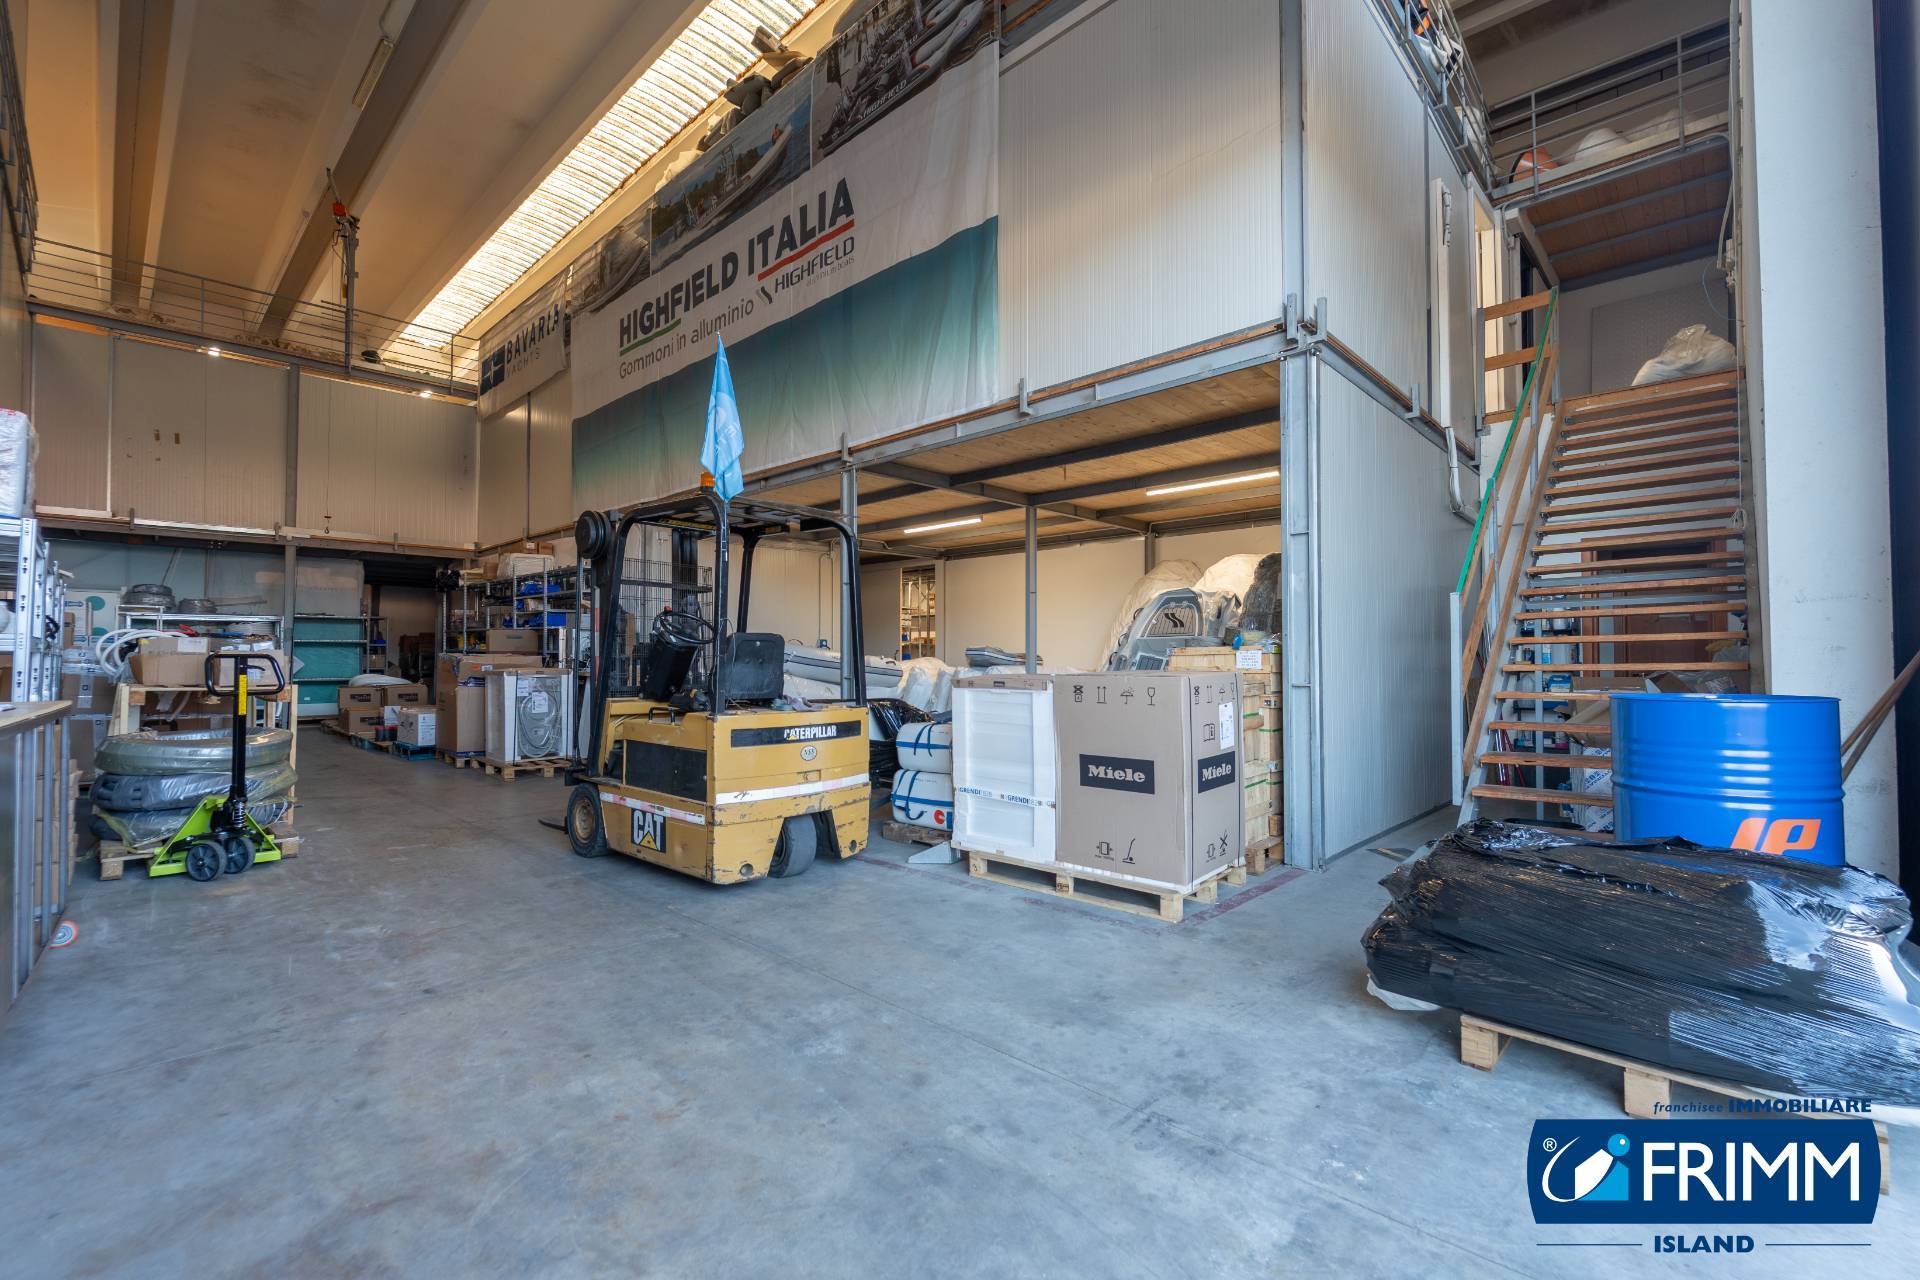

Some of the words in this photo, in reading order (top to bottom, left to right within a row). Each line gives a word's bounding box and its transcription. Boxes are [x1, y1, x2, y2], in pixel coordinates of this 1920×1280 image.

[619, 251, 739, 348] HIGHFIELD
[747, 177, 855, 277] ITALIA
[775, 236, 855, 293] HIGHFIELD
[506, 303, 559, 365] BAVARIA
[619, 339, 675, 380] Gommoni
[676, 333, 687, 353] in
[690, 298, 755, 344] alluminio
[784, 725, 837, 740] CATERPILLAR
[1088, 764, 1146, 783] Miele
[1201, 763, 1232, 782] Miele
[959, 787, 981, 796] GRENDI
[1007, 794, 1029, 805] GRENDI
[633, 810, 664, 851] CAT
